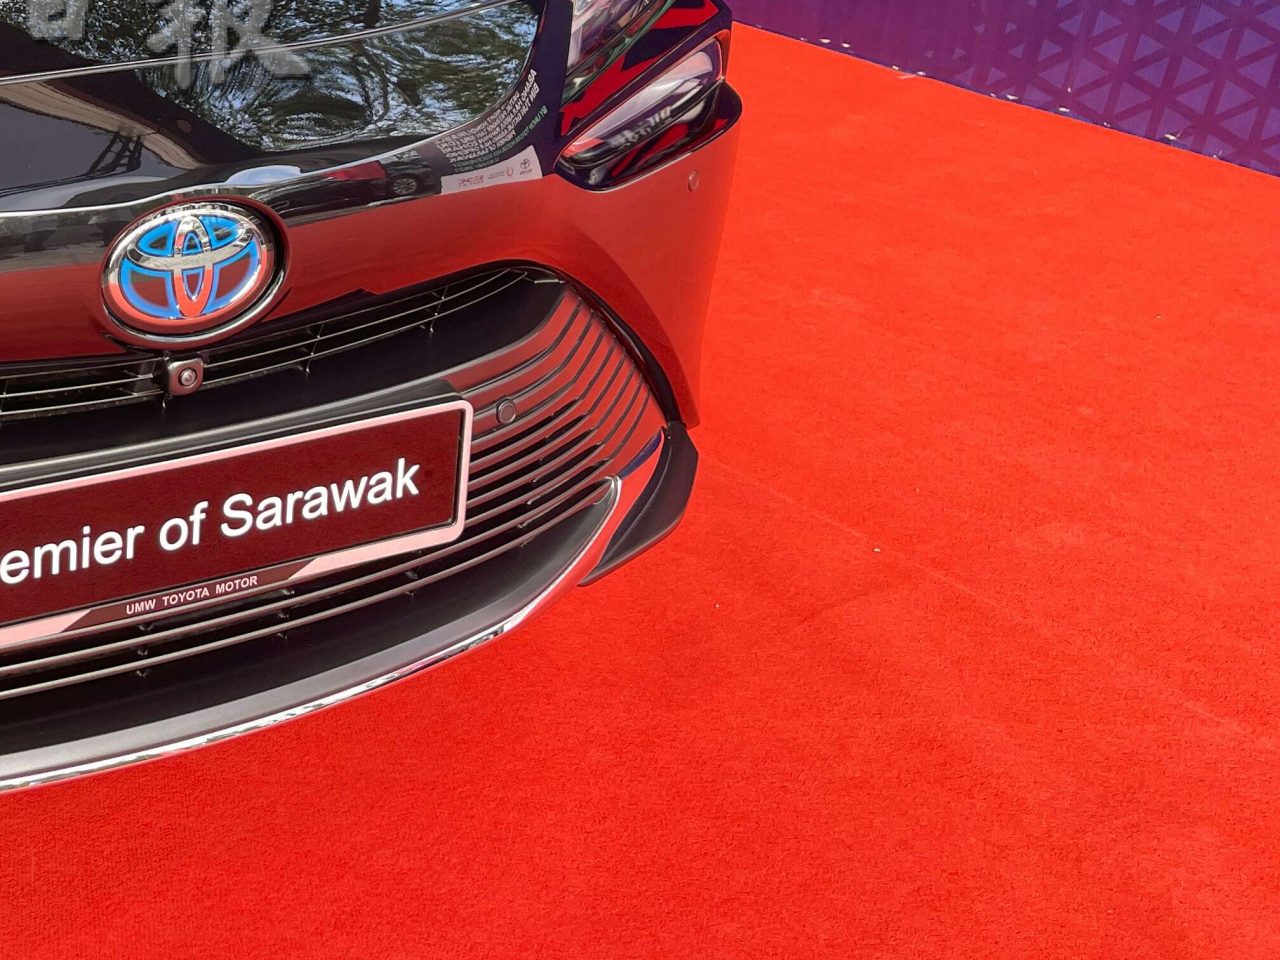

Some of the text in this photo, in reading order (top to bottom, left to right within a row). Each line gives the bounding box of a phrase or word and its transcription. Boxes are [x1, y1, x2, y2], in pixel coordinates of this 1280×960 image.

[159, 501, 207, 551] of
[220, 458, 419, 538] Sarawak
[126, 575, 258, 615] UMW TOYOTA MOTOR
